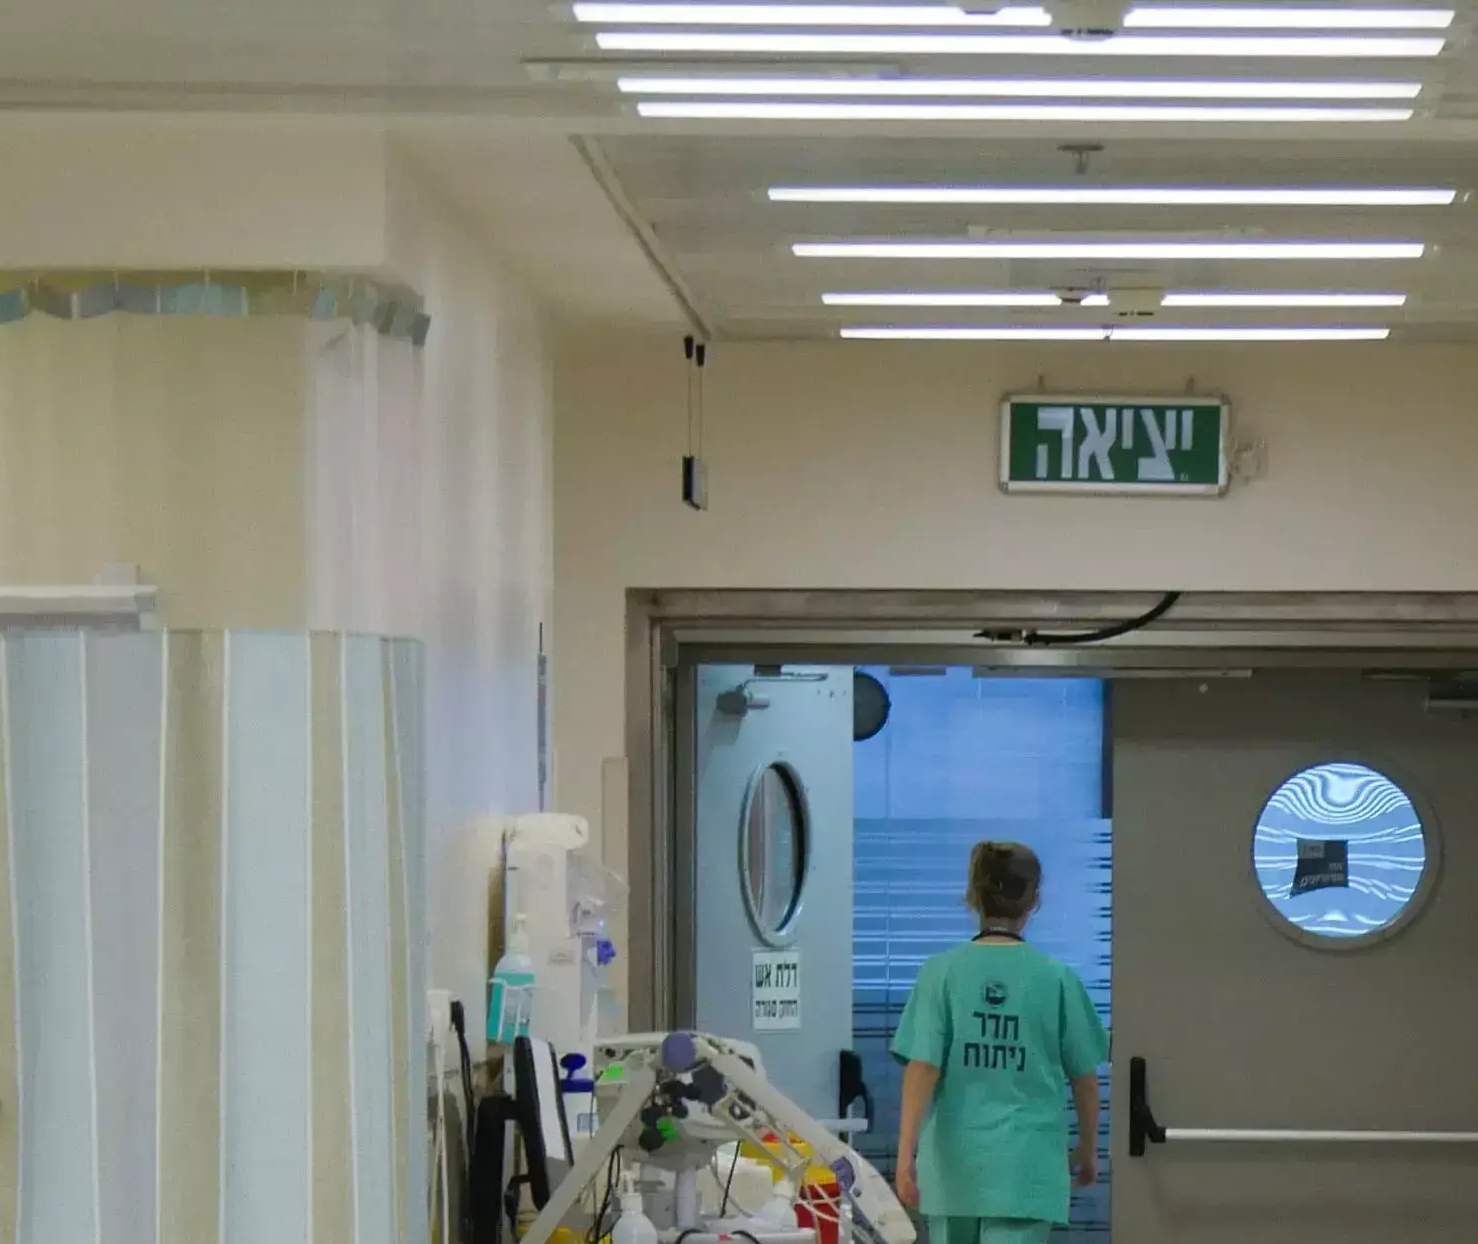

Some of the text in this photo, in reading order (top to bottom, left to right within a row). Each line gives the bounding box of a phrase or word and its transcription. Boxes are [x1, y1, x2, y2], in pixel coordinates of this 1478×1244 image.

[1035, 406, 1194, 481] יציאה
[754, 962, 798, 988] דלת אש
[972, 1011, 1019, 1041] חדר
[963, 1042, 1026, 1072] ניתוח
